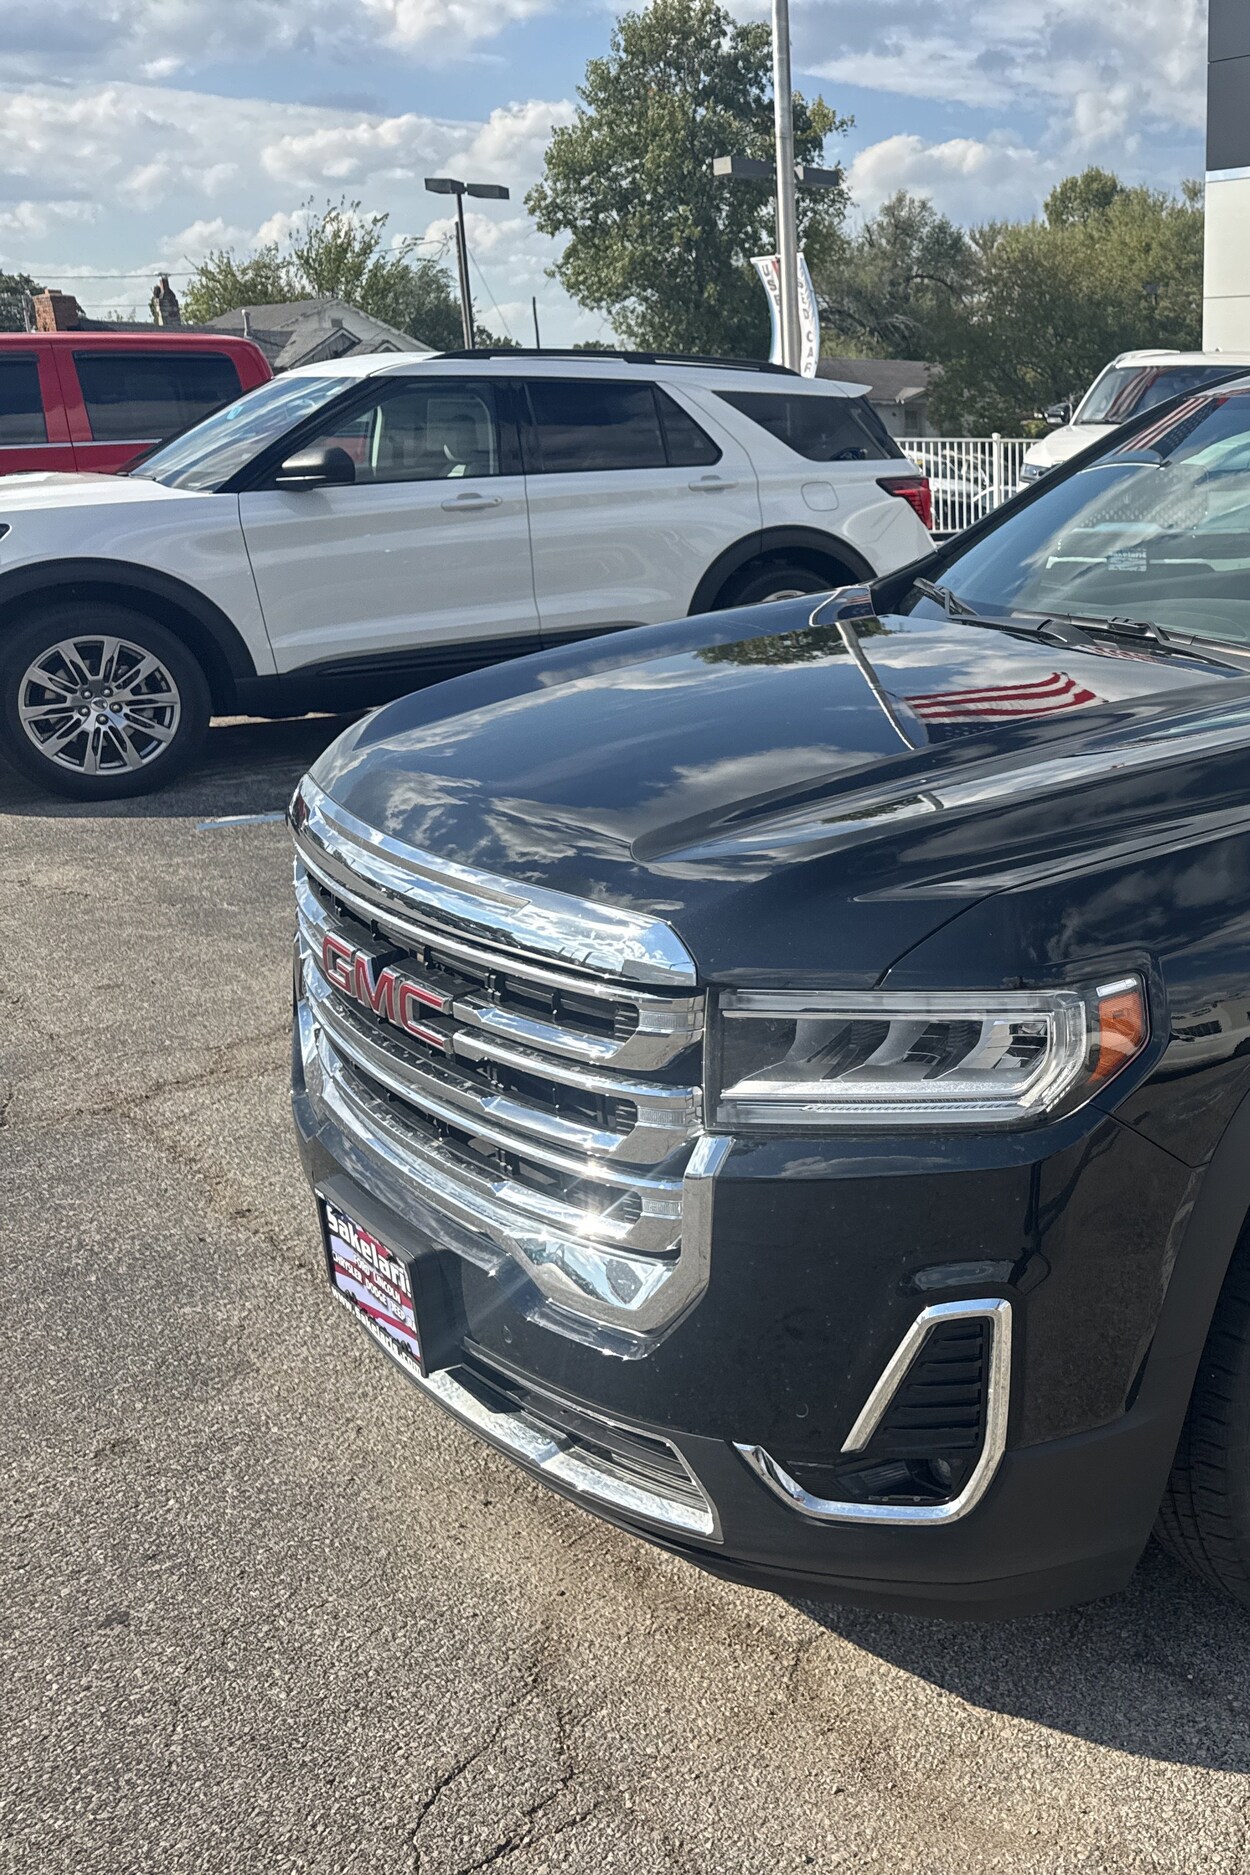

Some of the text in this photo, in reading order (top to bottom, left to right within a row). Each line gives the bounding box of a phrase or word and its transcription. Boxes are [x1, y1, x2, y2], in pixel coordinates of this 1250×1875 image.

[762, 264, 781, 313] USE
[322, 930, 453, 1056] GMC
[332, 1250, 363, 1284] CHRYSLER
[364, 1277, 388, 1306] DODGE
[389, 1298, 407, 1322] JEEP
[352, 1252, 402, 1305] FORD LINCOLN
